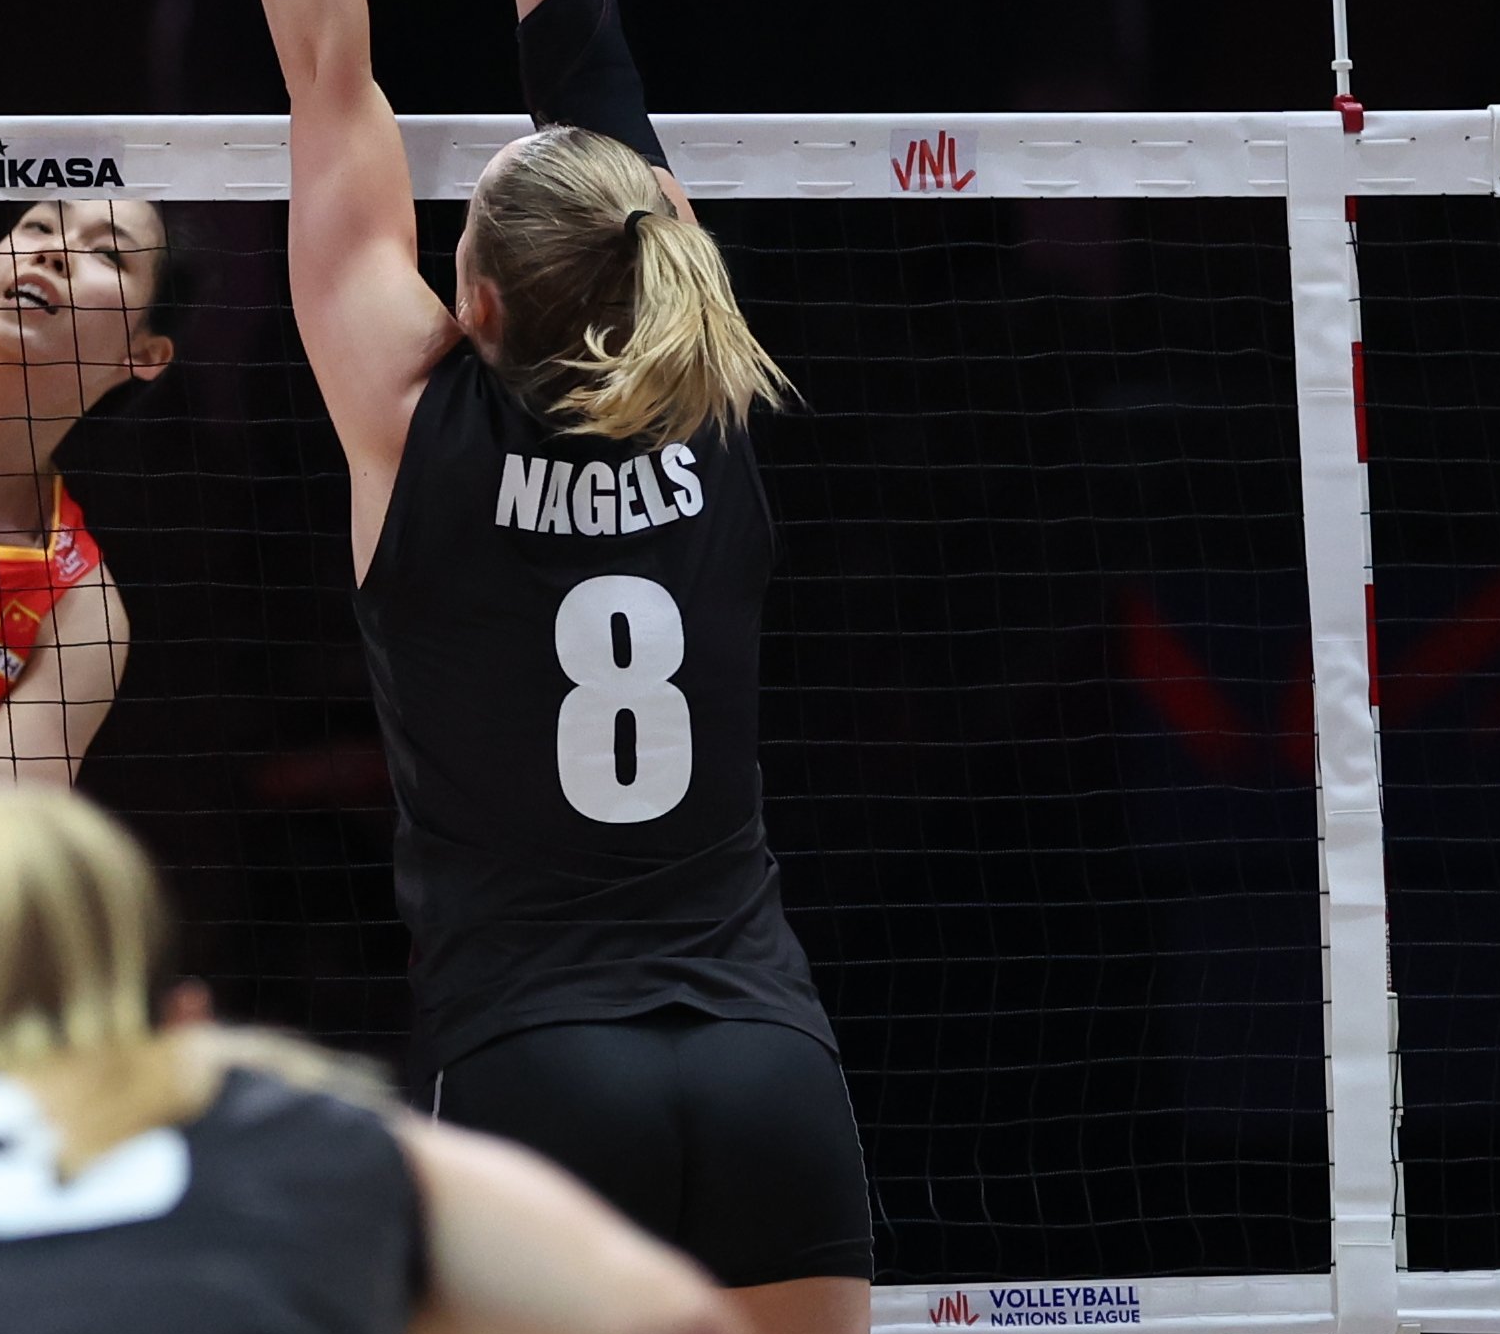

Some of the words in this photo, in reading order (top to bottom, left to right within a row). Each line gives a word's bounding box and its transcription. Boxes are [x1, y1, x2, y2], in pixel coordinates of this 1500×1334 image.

[891, 130, 976, 192] VNL
[495, 443, 704, 536] NAGELS
[555, 575, 692, 824] 8
[929, 1291, 980, 1326] VNL
[990, 1286, 1140, 1309] VOLLEYBALL
[991, 1311, 1068, 1327] NATIONS
[1074, 1309, 1140, 1325] LEAGUE
